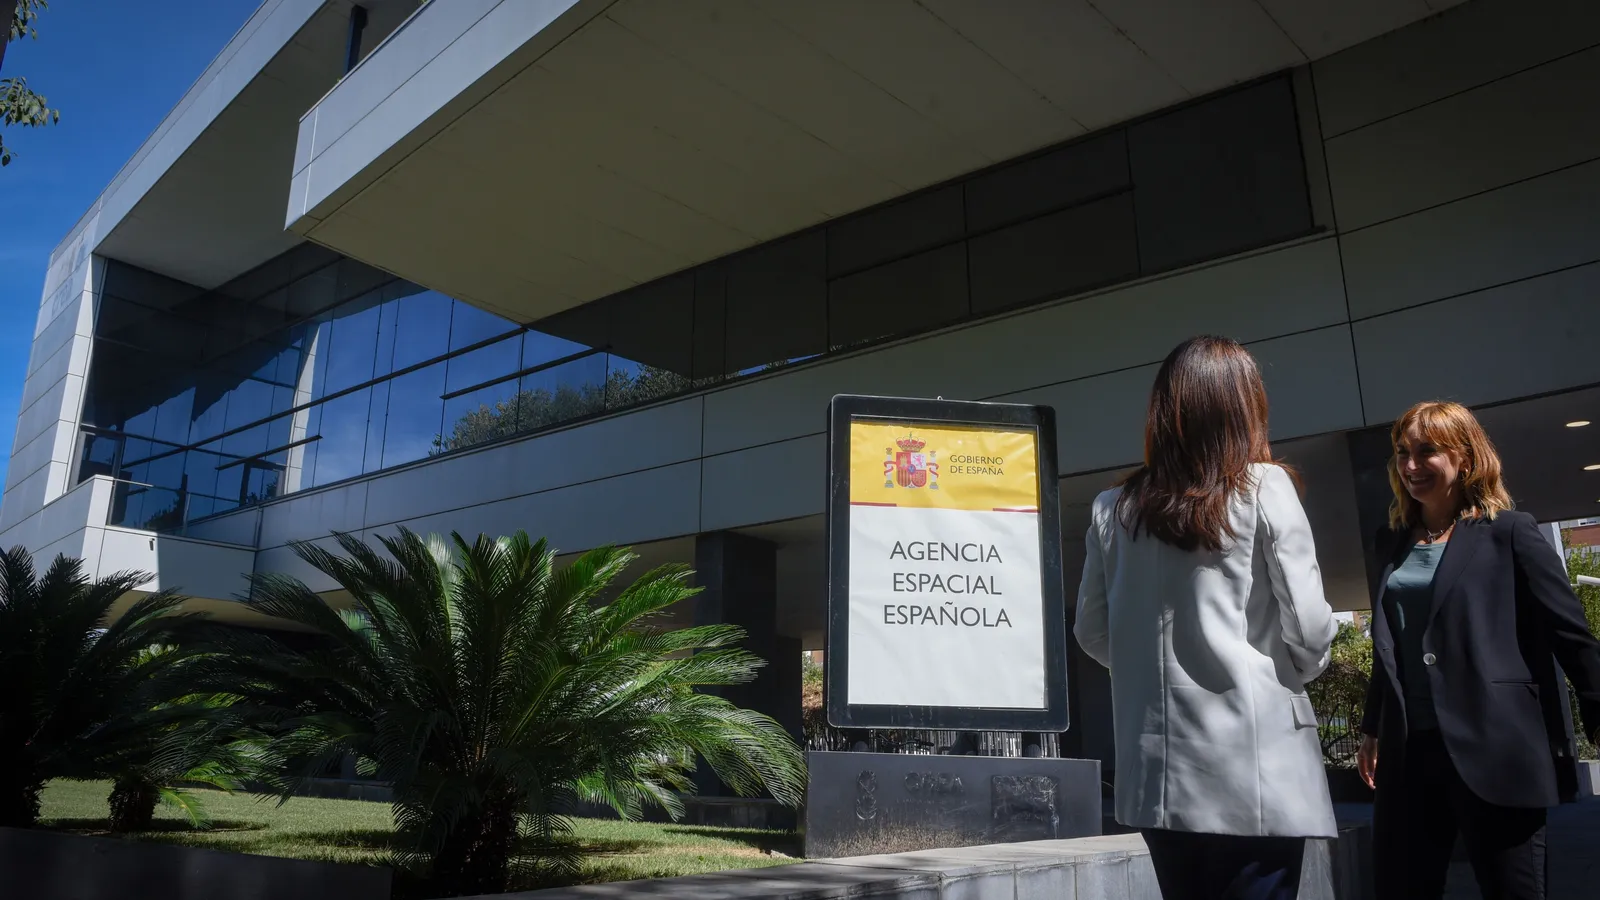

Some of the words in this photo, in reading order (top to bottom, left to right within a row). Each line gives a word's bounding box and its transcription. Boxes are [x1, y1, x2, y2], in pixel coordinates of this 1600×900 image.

[950, 454, 1004, 466] GOBIERNO
[950, 465, 963, 474] DE
[967, 465, 1004, 476] ESPAÑA
[889, 540, 1003, 564] AGENCIA
[893, 572, 1003, 595] ESPACIAL
[883, 601, 1012, 628] ESPAÑOLA
